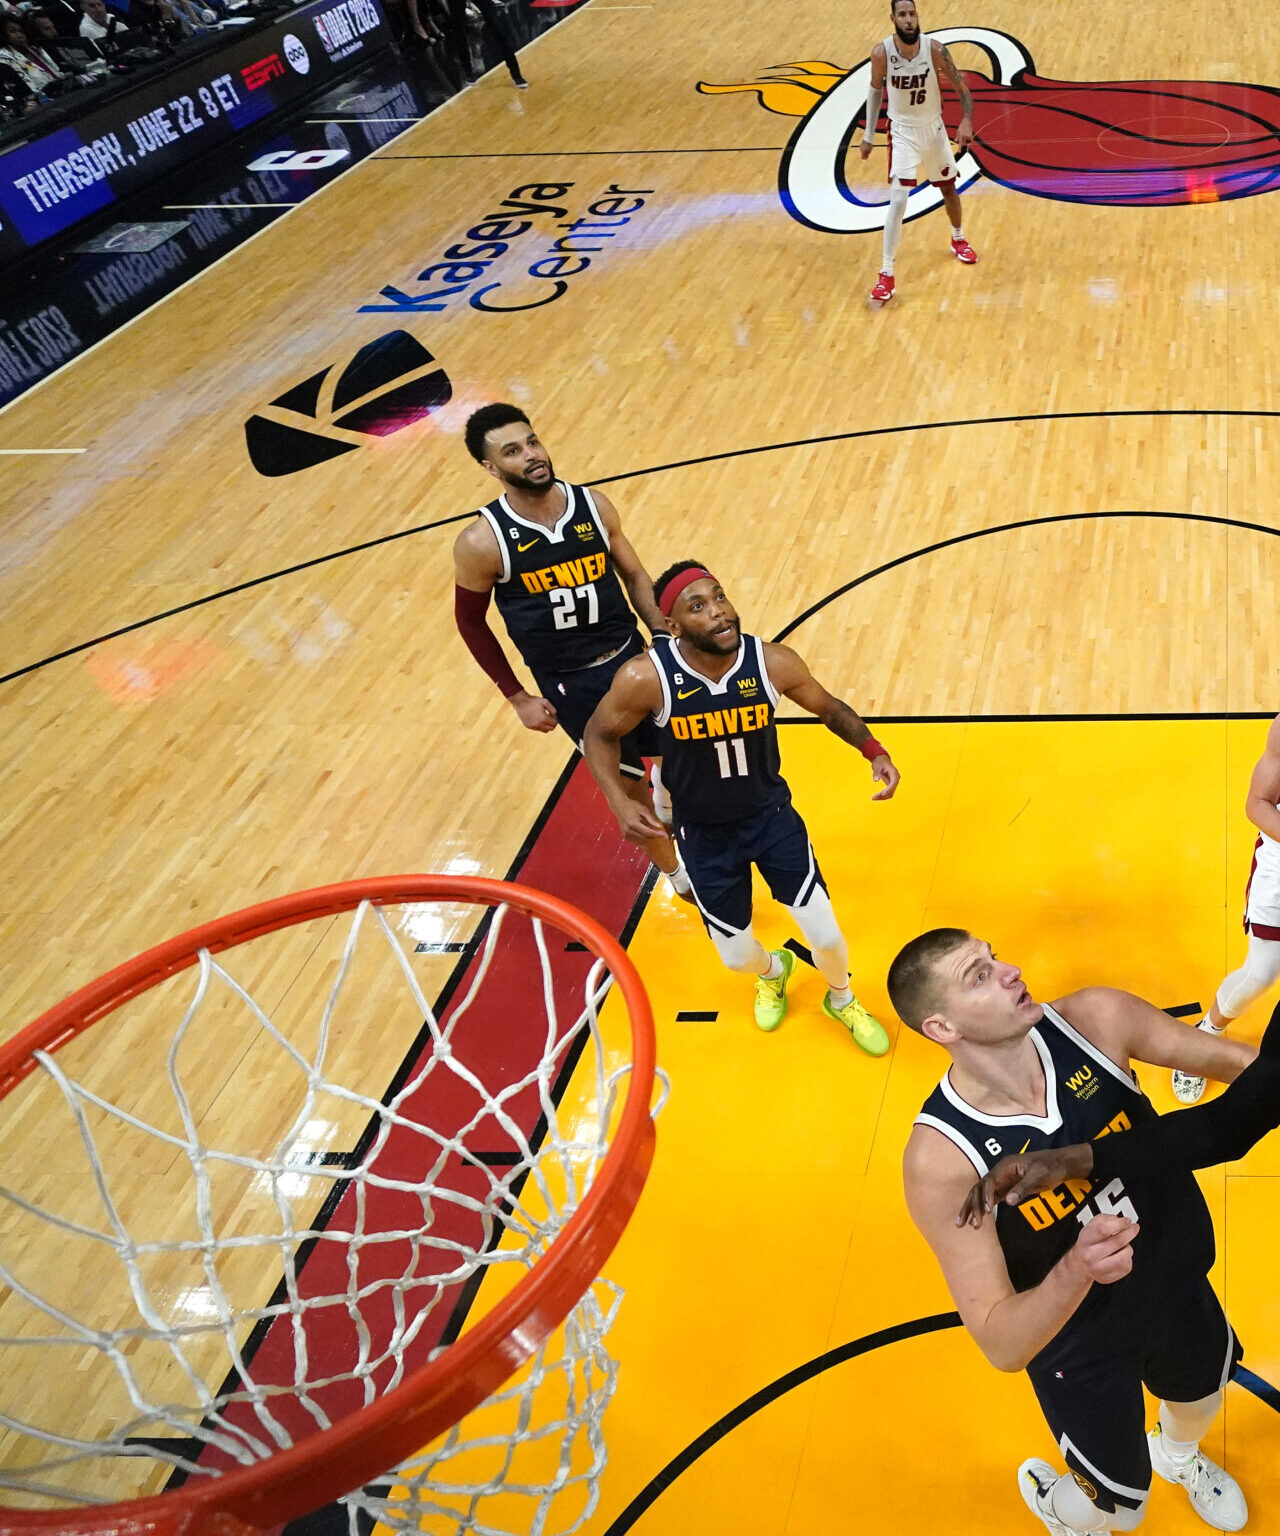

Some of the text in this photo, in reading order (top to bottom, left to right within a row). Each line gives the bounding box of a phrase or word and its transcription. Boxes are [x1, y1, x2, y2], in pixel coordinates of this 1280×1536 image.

[320, 3, 359, 48] DRAFT
[240, 53, 285, 91] ESPN
[891, 68, 930, 89] HEAT
[909, 89, 927, 106] 16
[13, 74, 241, 212] THURSDAY, JUNE 22 8 ET
[356, 182, 576, 313] Kaseya
[469, 184, 655, 312] Center
[509, 527, 520, 539] 6
[573, 522, 592, 534] WU
[520, 552, 606, 594] DENVER
[548, 583, 599, 630] 27
[674, 673, 684, 685] 6
[737, 677, 757, 689] WU
[670, 703, 769, 740] DENVER
[714, 738, 748, 779] 11
[1065, 1065, 1092, 1091] WU
[1075, 1077, 1099, 1099] Western
[1083, 1084, 1099, 1101] Union
[984, 1138, 1002, 1156] 6
